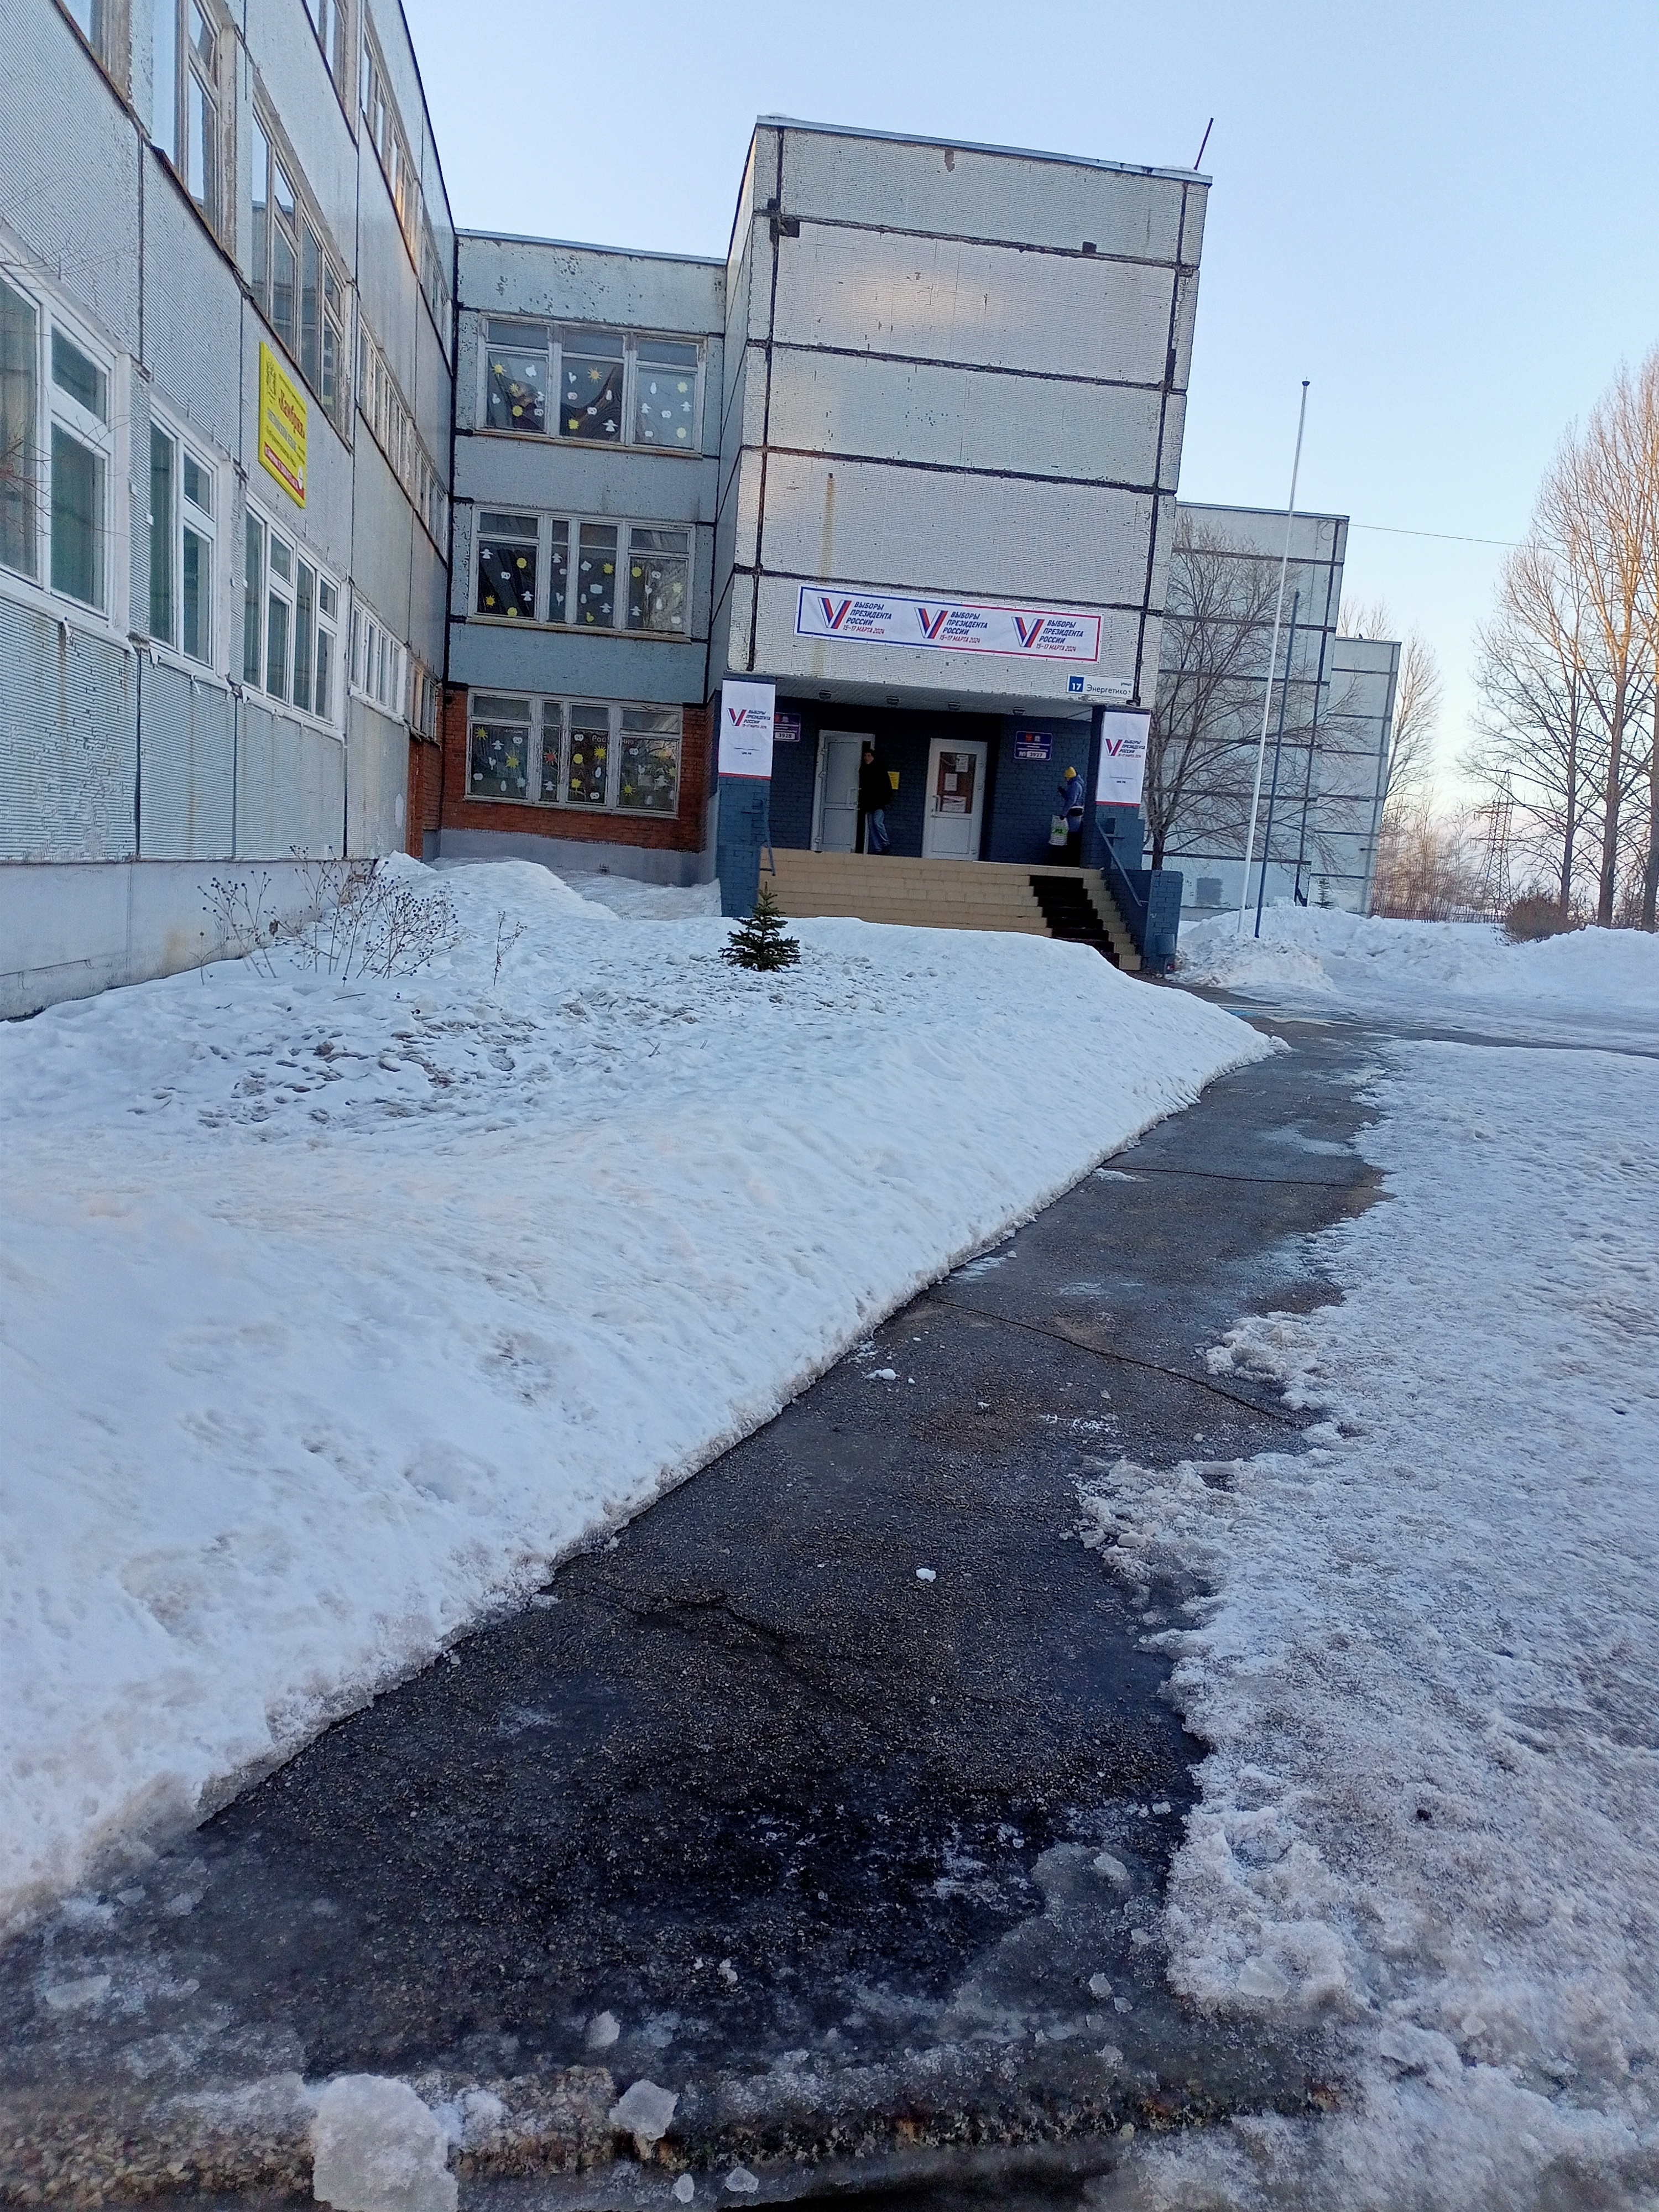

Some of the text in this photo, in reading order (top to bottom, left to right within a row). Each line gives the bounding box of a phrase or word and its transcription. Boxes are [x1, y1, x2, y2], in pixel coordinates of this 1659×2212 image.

[854, 602, 884, 610] ВЫБОРЫ
[850, 609, 892, 619] ПРЕЗИДЕНТА
[951, 611, 980, 619] ВЫБОРЫ
[846, 617, 873, 626] РОССИИ
[946, 619, 988, 629] ПРЕЗИДЕНТА
[1047, 620, 1076, 628] ВЫБОРЫ
[942, 627, 969, 635] РОССИИ
[1043, 628, 1084, 637] ПРЕЗИДЕНТА
